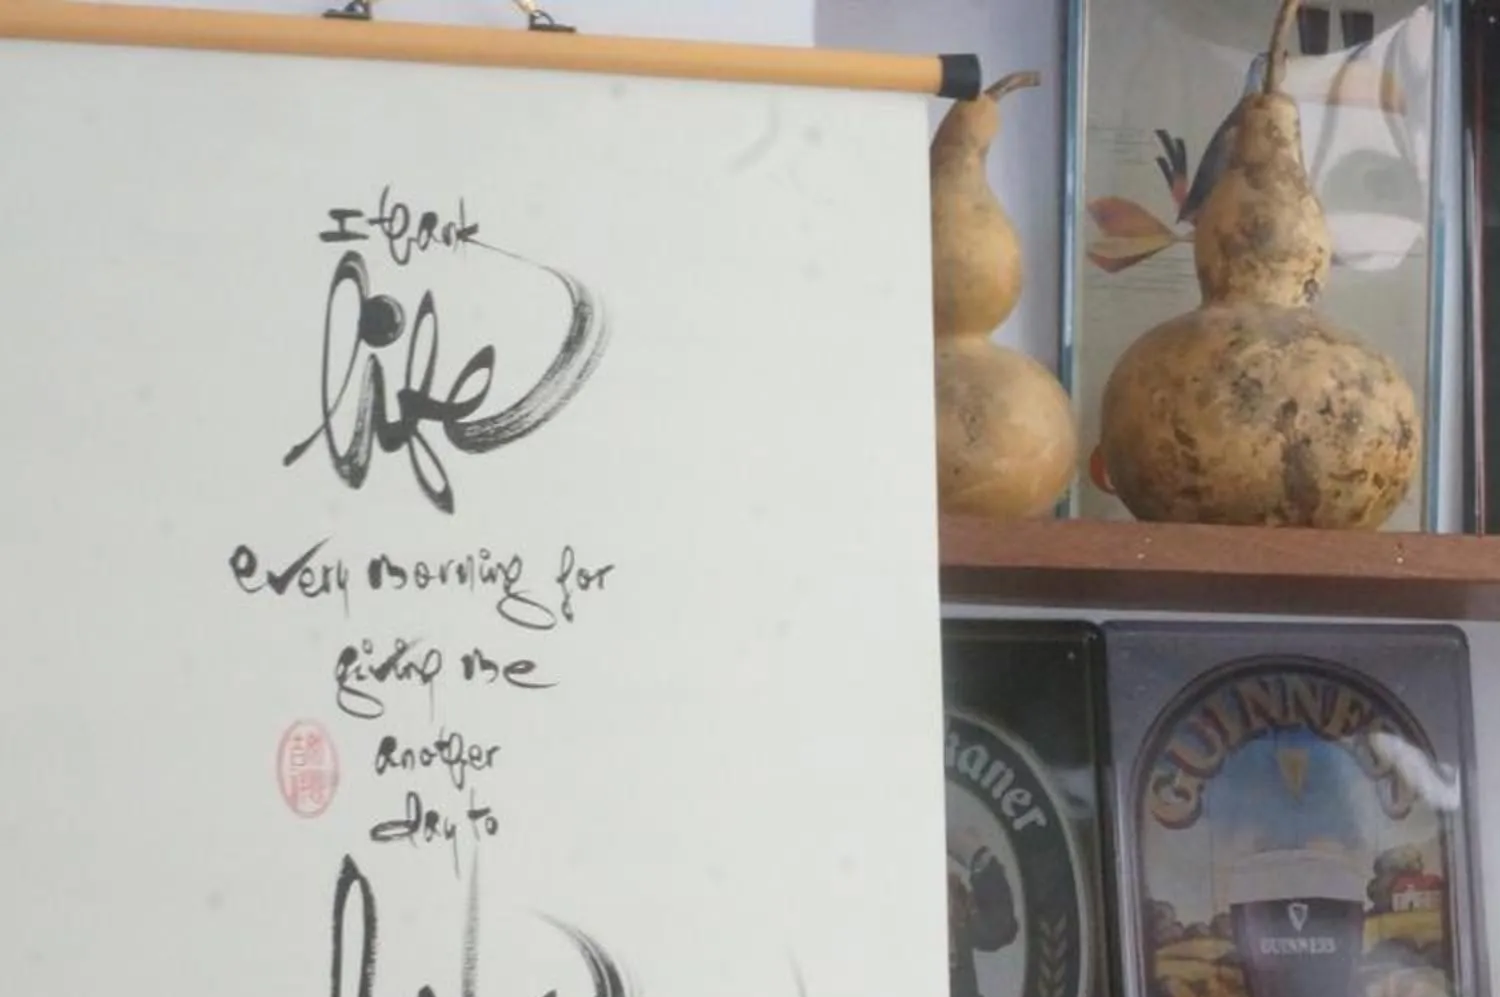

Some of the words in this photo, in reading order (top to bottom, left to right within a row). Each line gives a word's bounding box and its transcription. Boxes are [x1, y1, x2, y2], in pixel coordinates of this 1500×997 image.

[319, 209, 370, 242] I
[283, 248, 612, 515] life
[229, 537, 350, 618] every
[368, 548, 557, 629] morning
[555, 546, 615, 622] for
[336, 638, 443, 720] giving
[462, 649, 561, 688] me
[374, 727, 501, 791] another
[370, 791, 461, 879] day
[468, 788, 500, 842] to
[1258, 935, 1337, 955] GUINNESS
